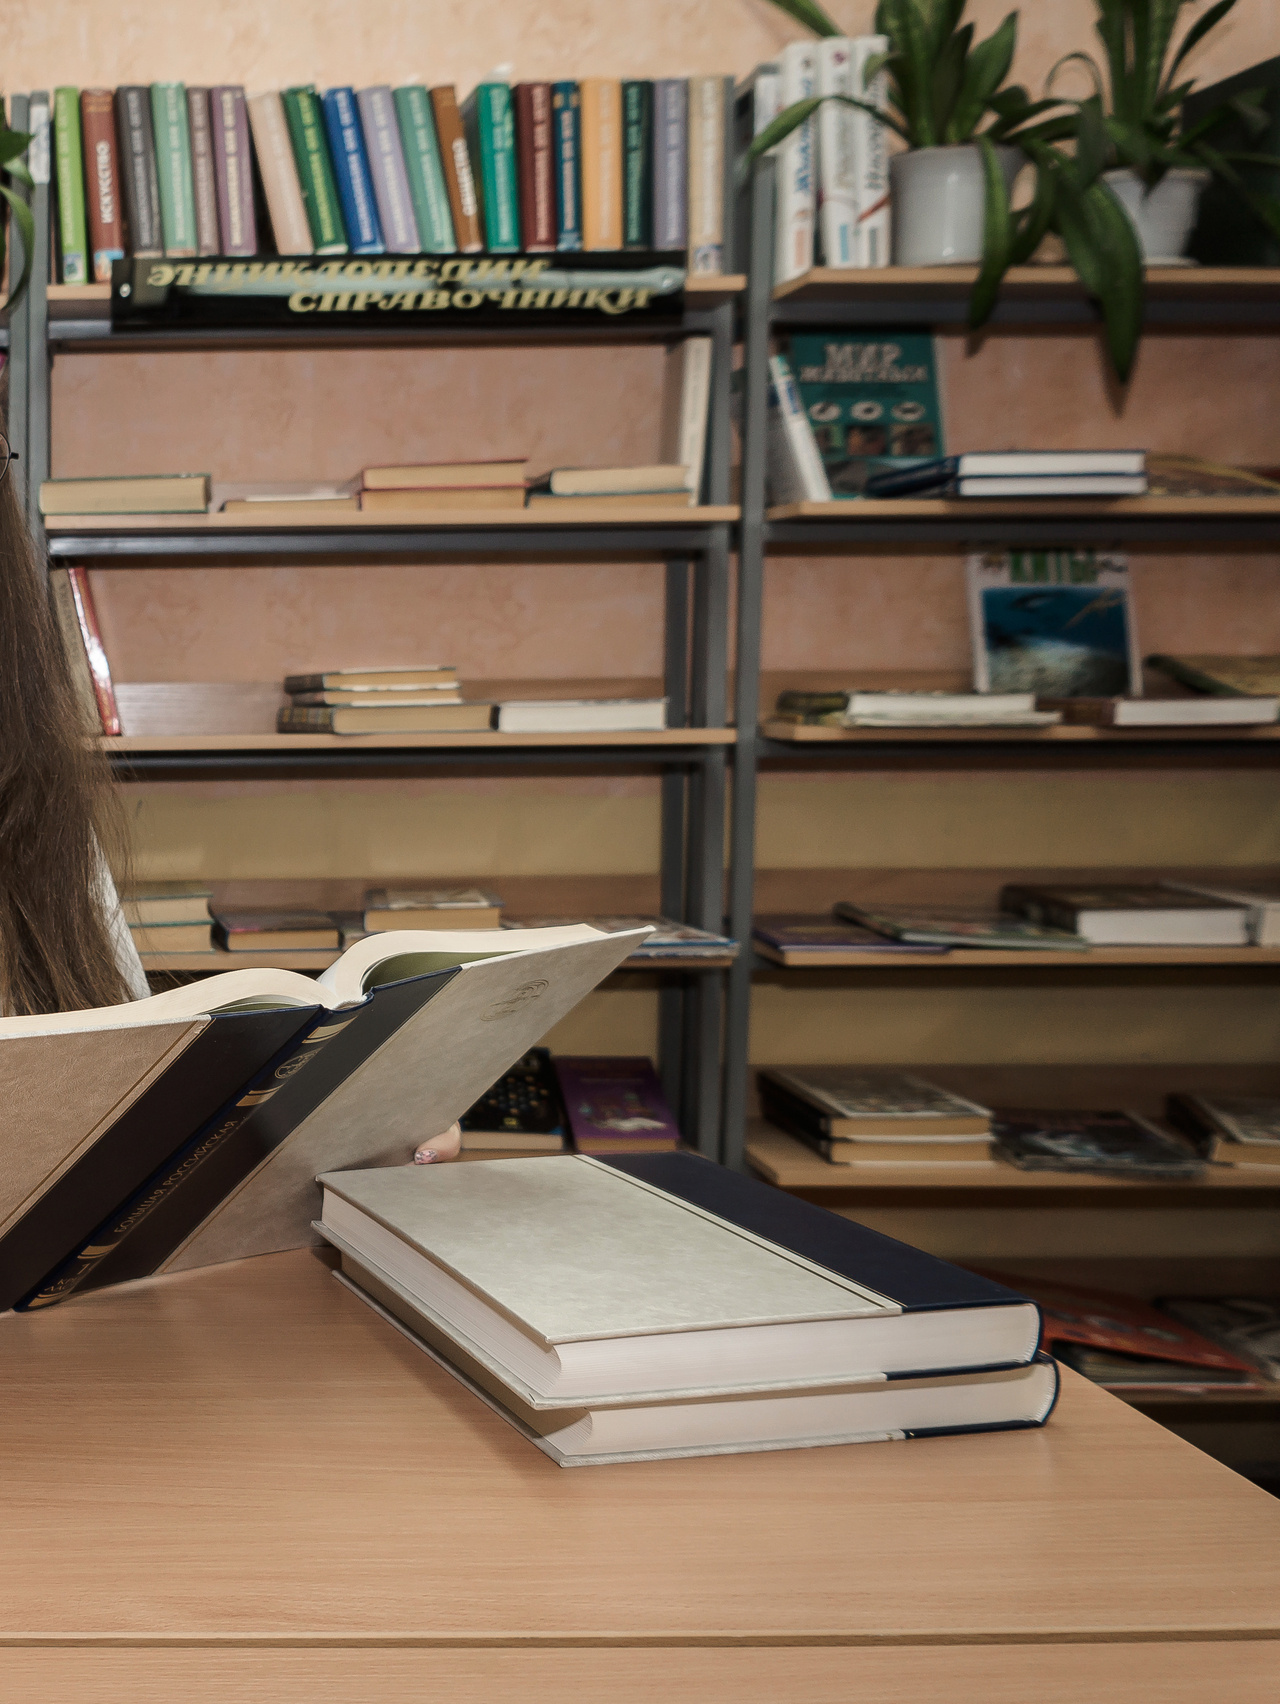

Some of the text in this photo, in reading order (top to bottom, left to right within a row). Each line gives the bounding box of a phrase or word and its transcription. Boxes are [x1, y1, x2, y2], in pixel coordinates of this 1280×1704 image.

[95, 140, 115, 224] ИСКУССТВО
[147, 259, 551, 291] ЭНЦИКЛОПЕДИИ
[288, 289, 656, 315] СПРАВОЧНИКИ
[824, 343, 902, 371] МИР
[113, 1120, 239, 1233] БОЛЬШАЯ РОССИЙСКАЯ
